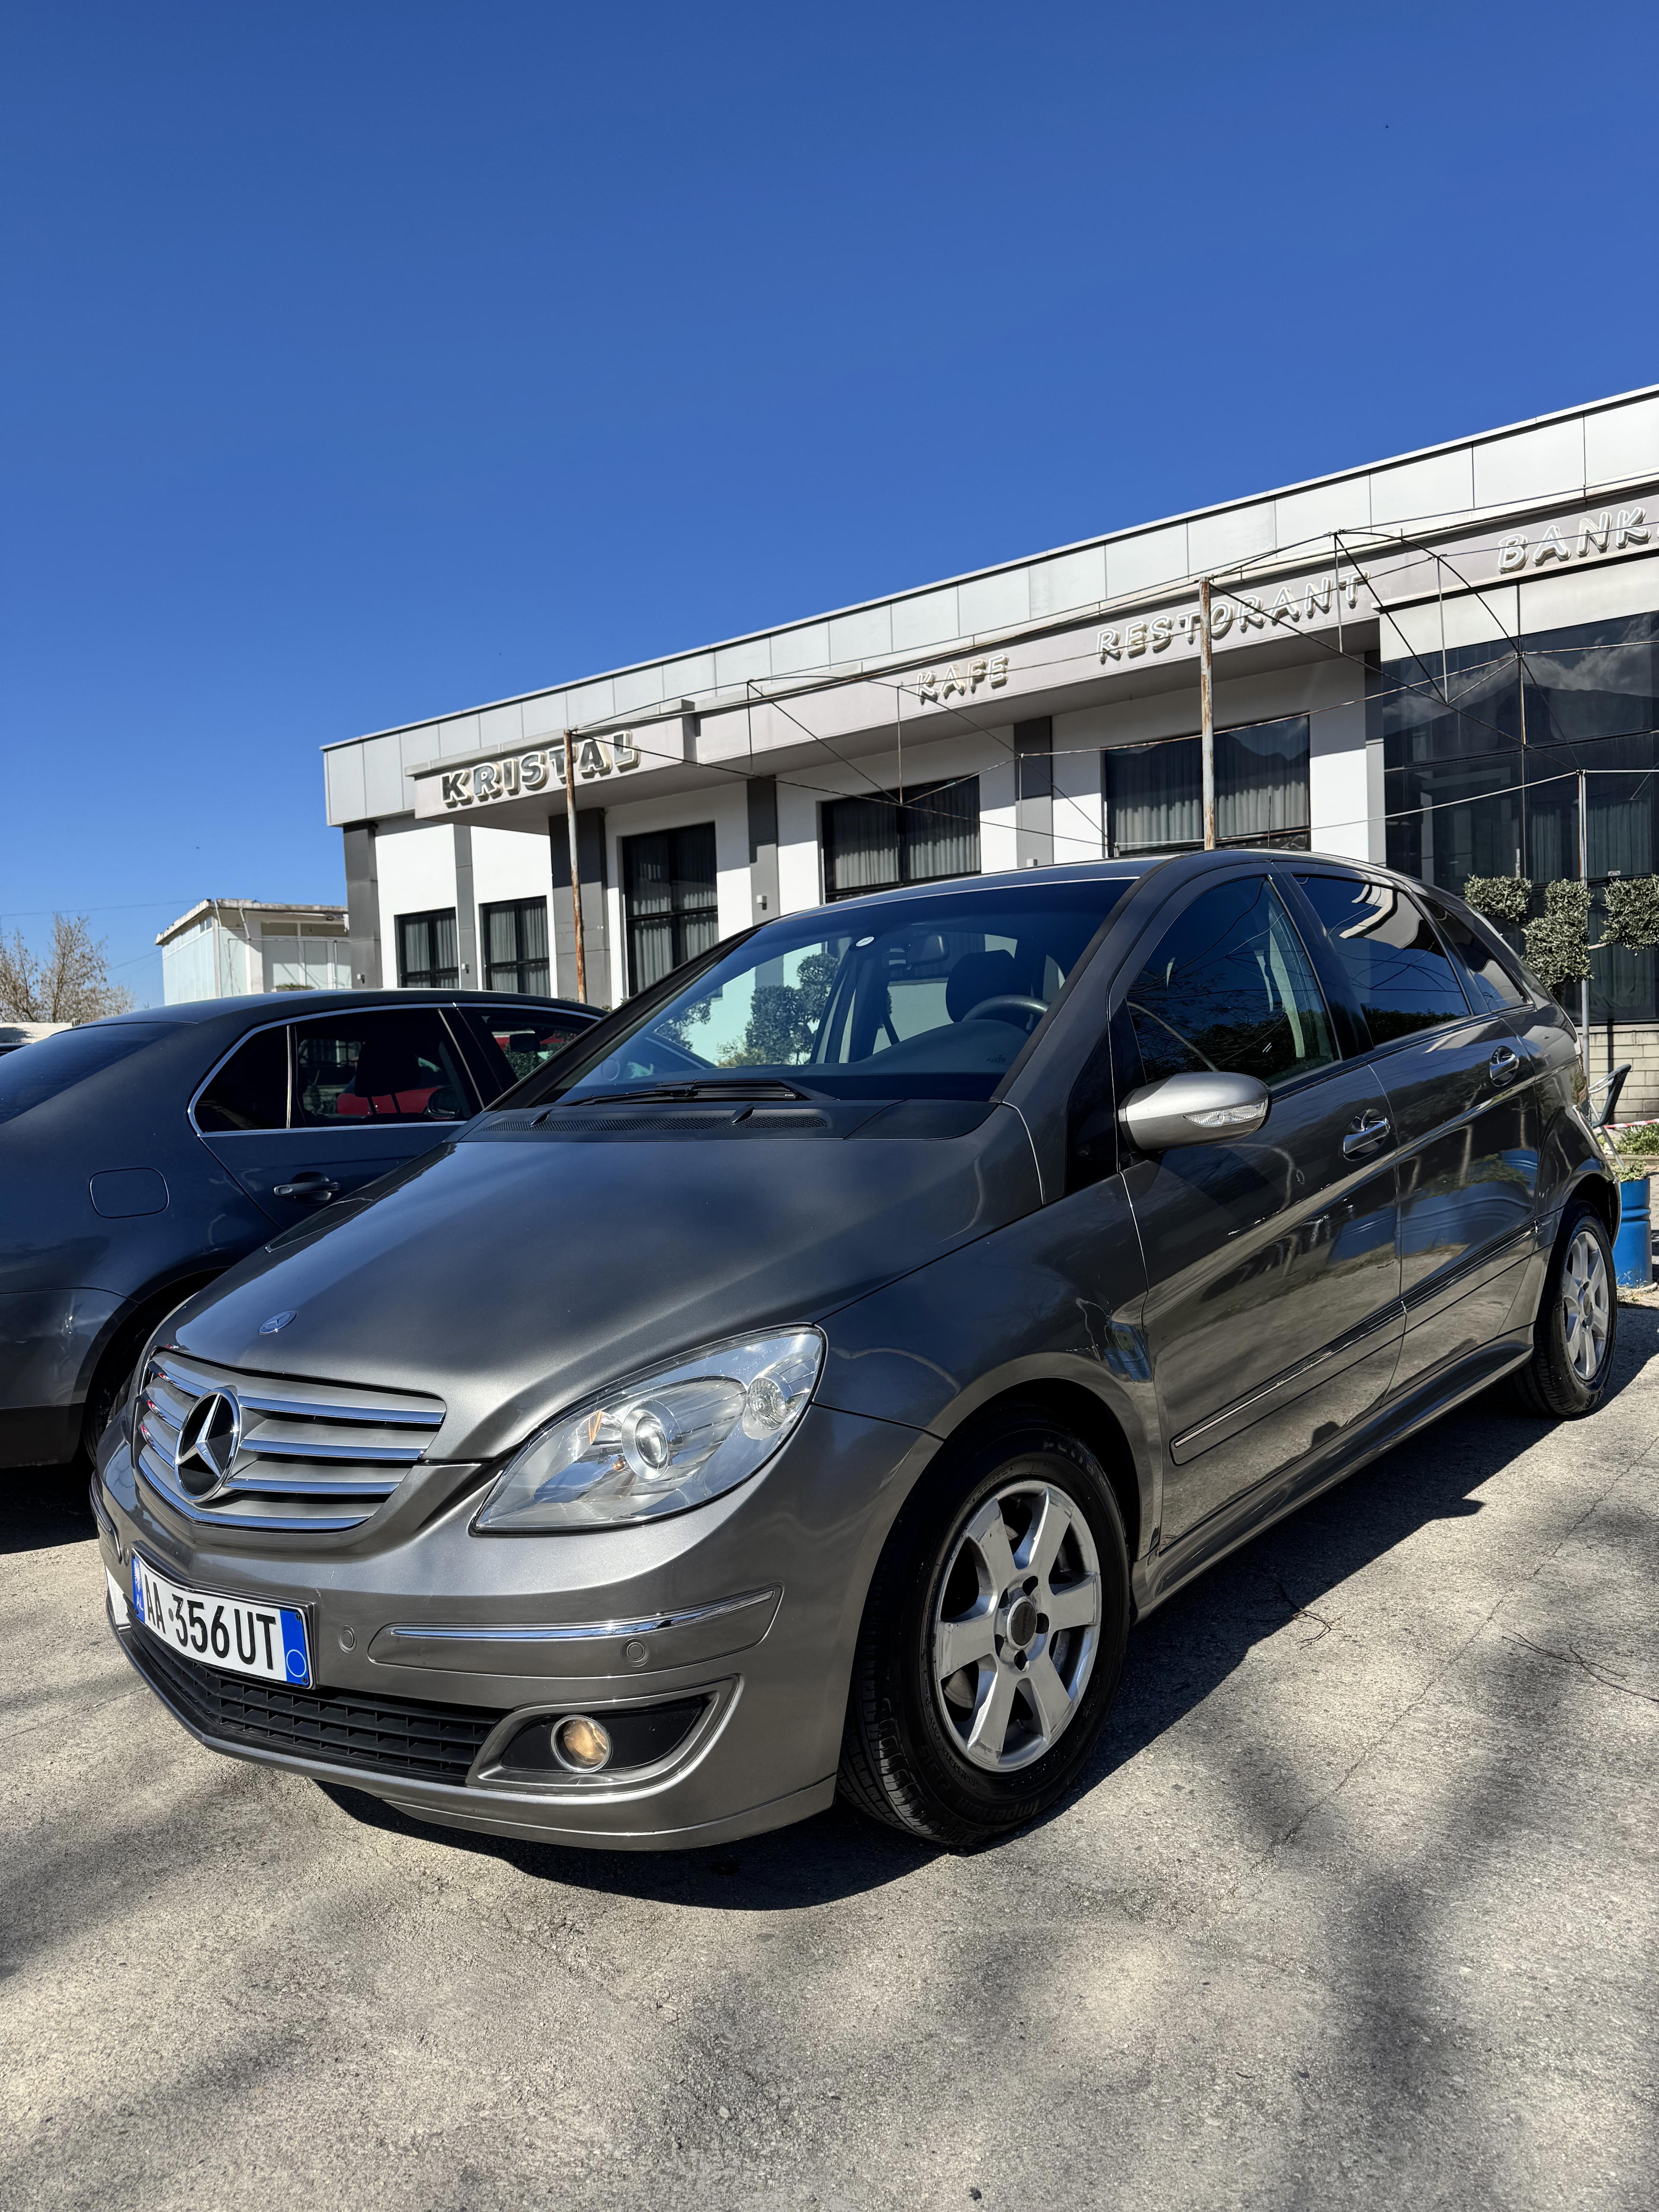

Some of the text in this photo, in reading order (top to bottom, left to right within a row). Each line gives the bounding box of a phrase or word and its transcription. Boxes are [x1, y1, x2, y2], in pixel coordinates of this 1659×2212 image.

[1498, 506, 1659, 571] BANK
[916, 569, 1370, 702] KAFE RESTORANT
[441, 731, 639, 806] KRISTAL
[144, 1573, 166, 1634] AA
